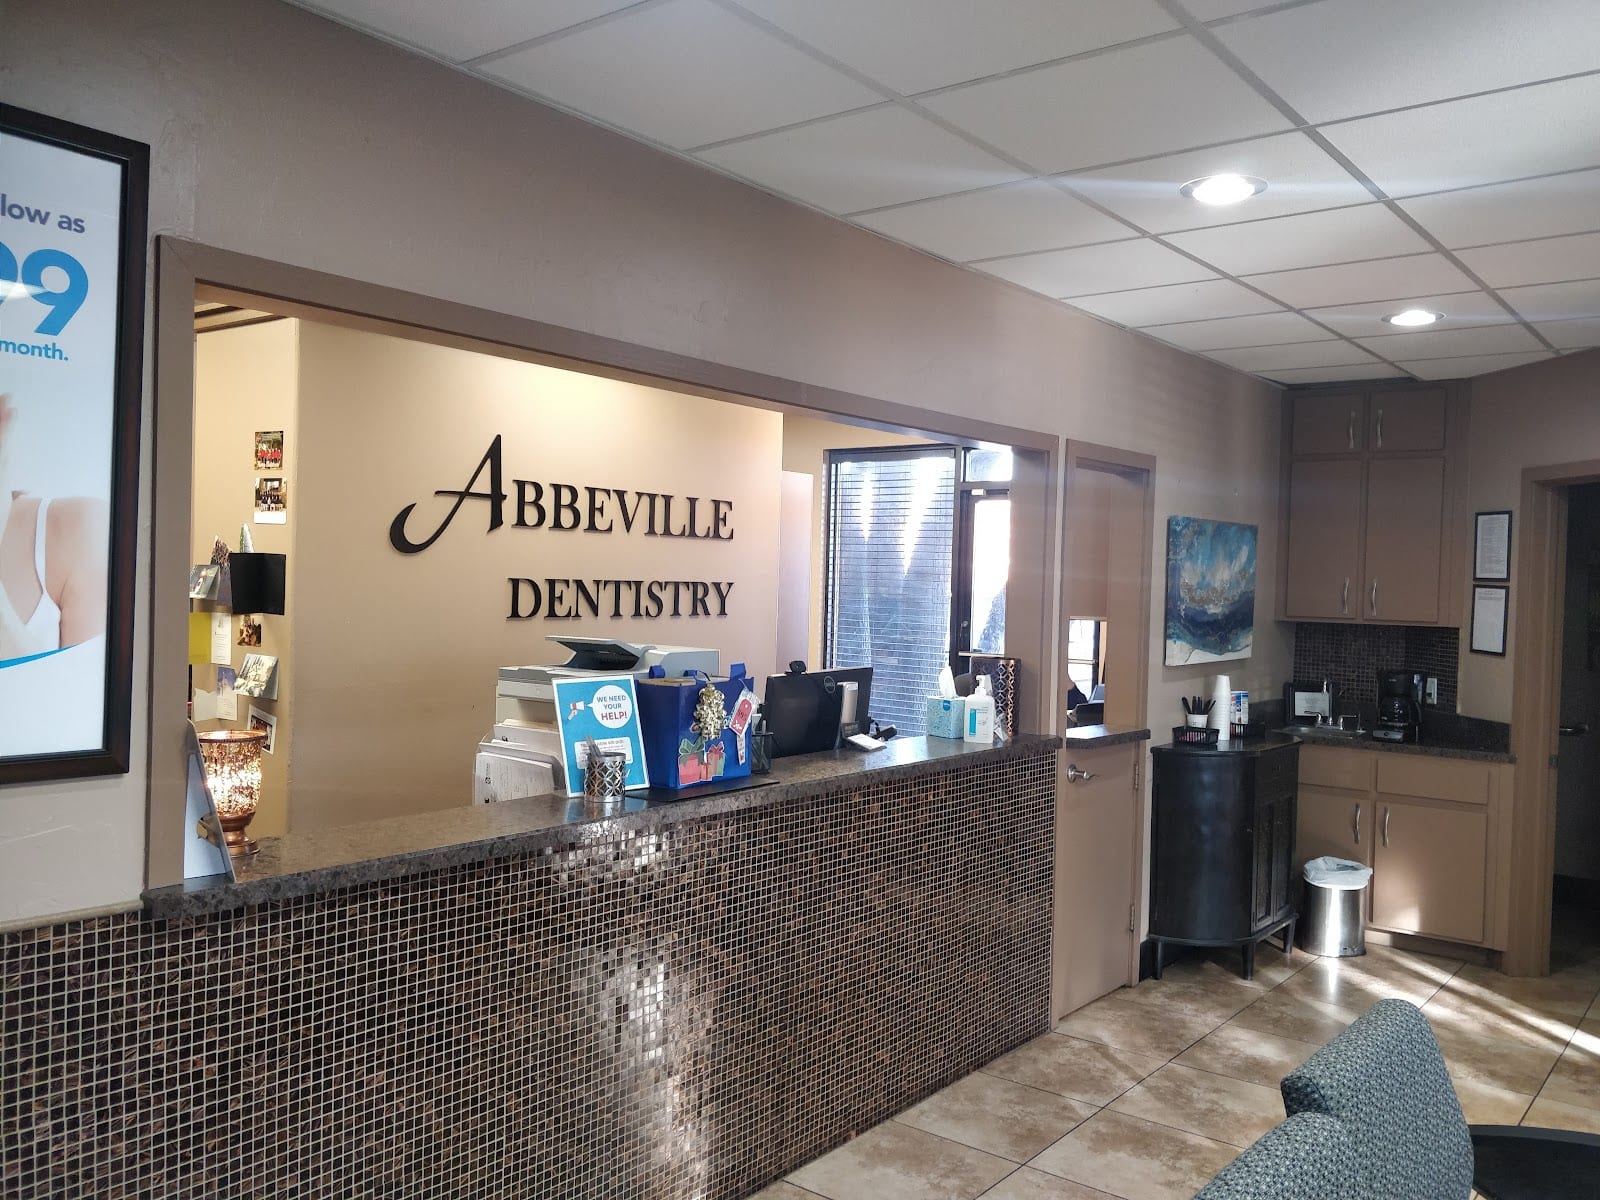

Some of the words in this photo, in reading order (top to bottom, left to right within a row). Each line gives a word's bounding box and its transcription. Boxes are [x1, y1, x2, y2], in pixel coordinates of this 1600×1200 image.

[0, 193, 50, 225] low
[57, 215, 85, 233] as
[0, 340, 69, 361] month.
[389, 434, 735, 554] ABBEVILLE
[506, 577, 735, 619] DENTISTRY
[601, 711, 627, 720] HELP!
